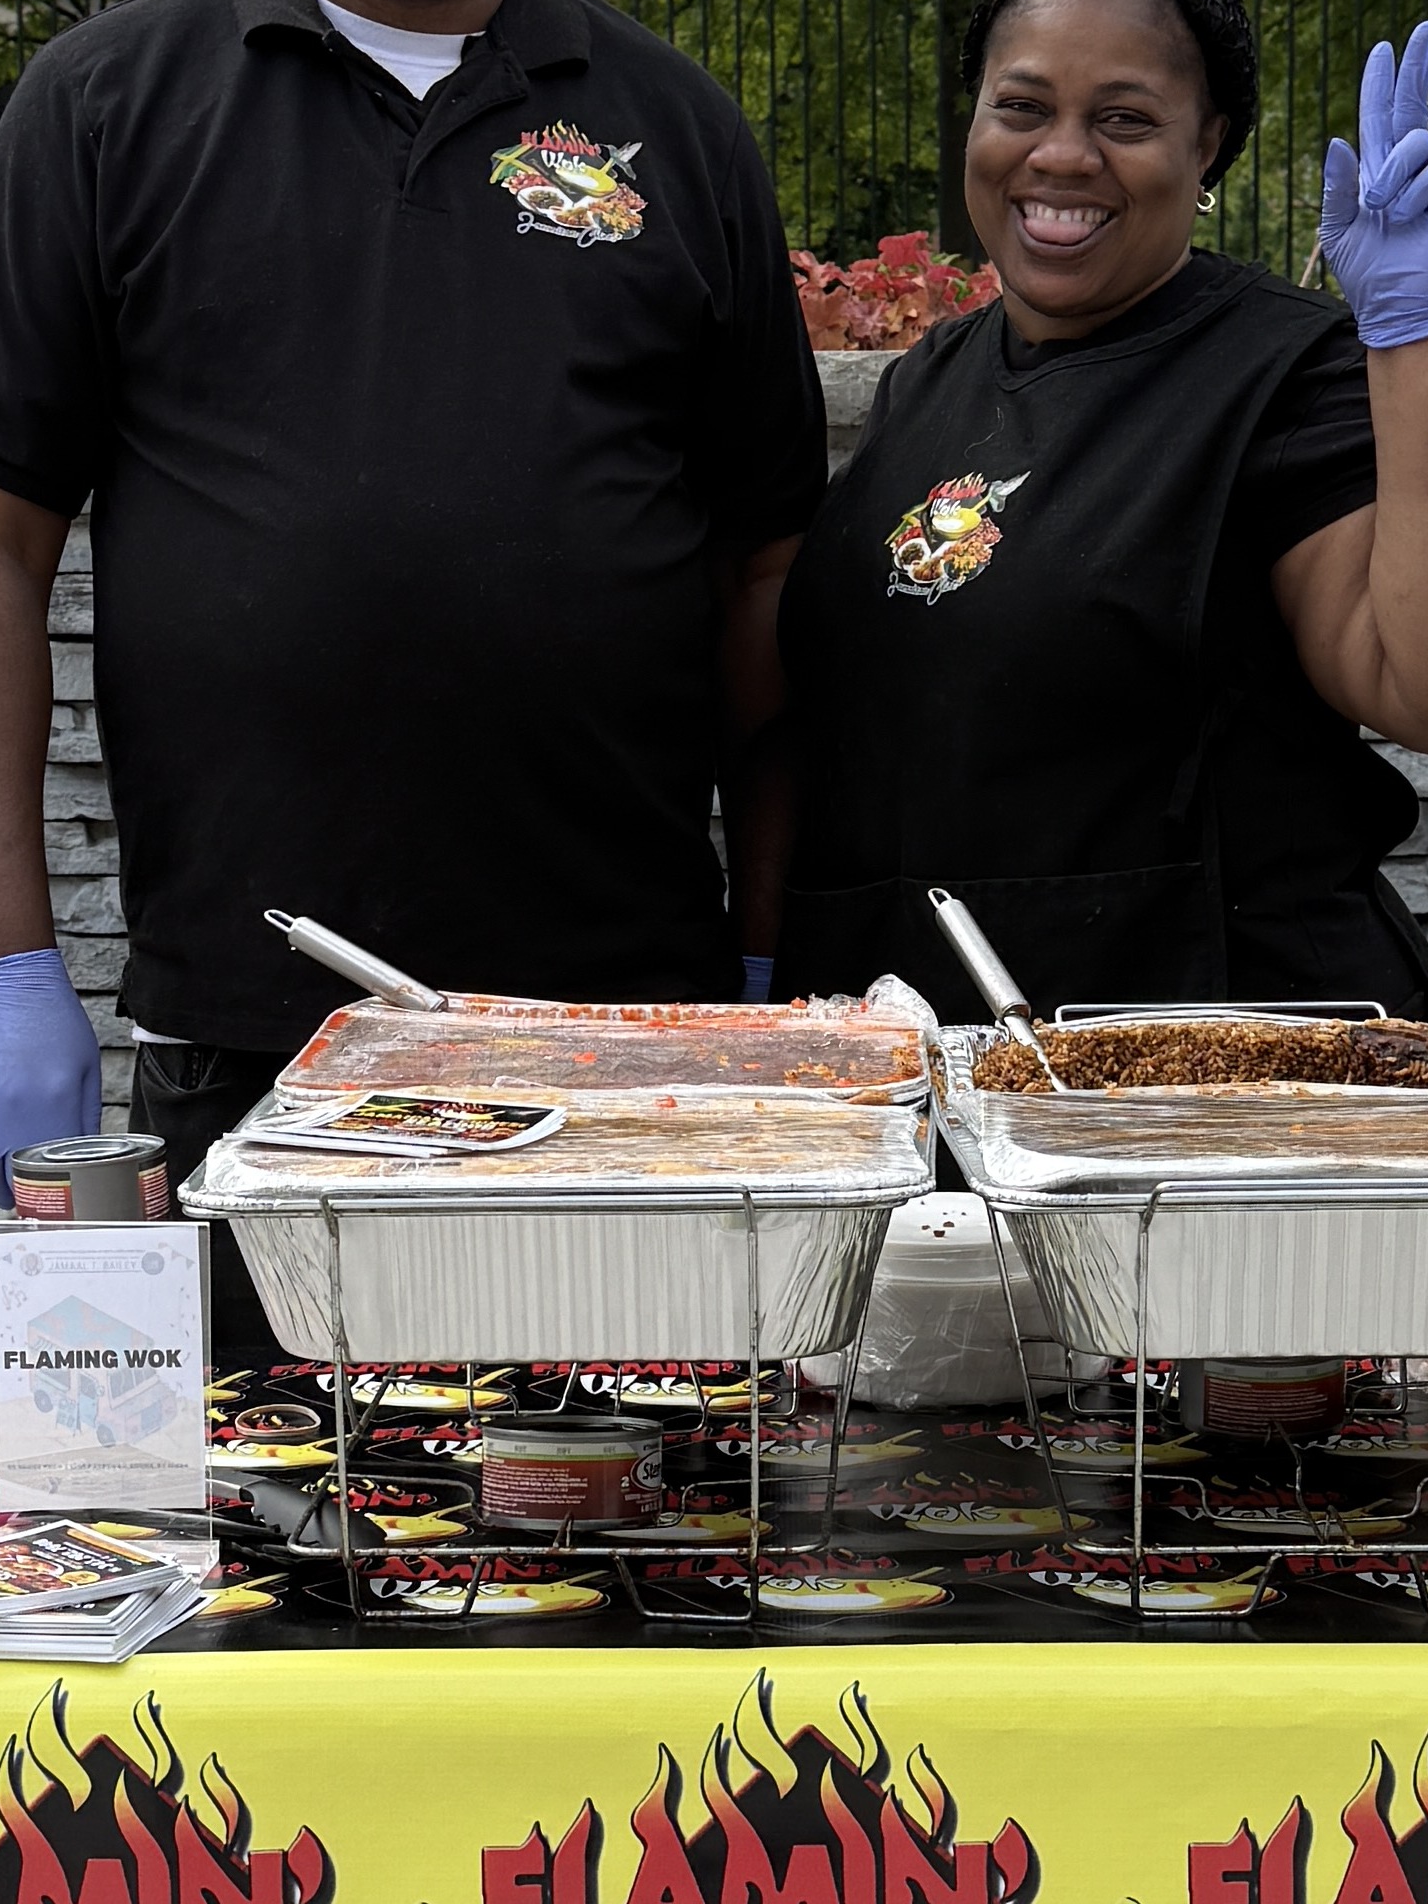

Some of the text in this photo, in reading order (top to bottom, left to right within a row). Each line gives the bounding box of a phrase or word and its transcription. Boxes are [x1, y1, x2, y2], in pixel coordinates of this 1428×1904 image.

[540, 149, 587, 172] Wok
[3, 1348, 182, 1370] FLAMING WOK
[867, 1501, 1003, 1523] Wok
